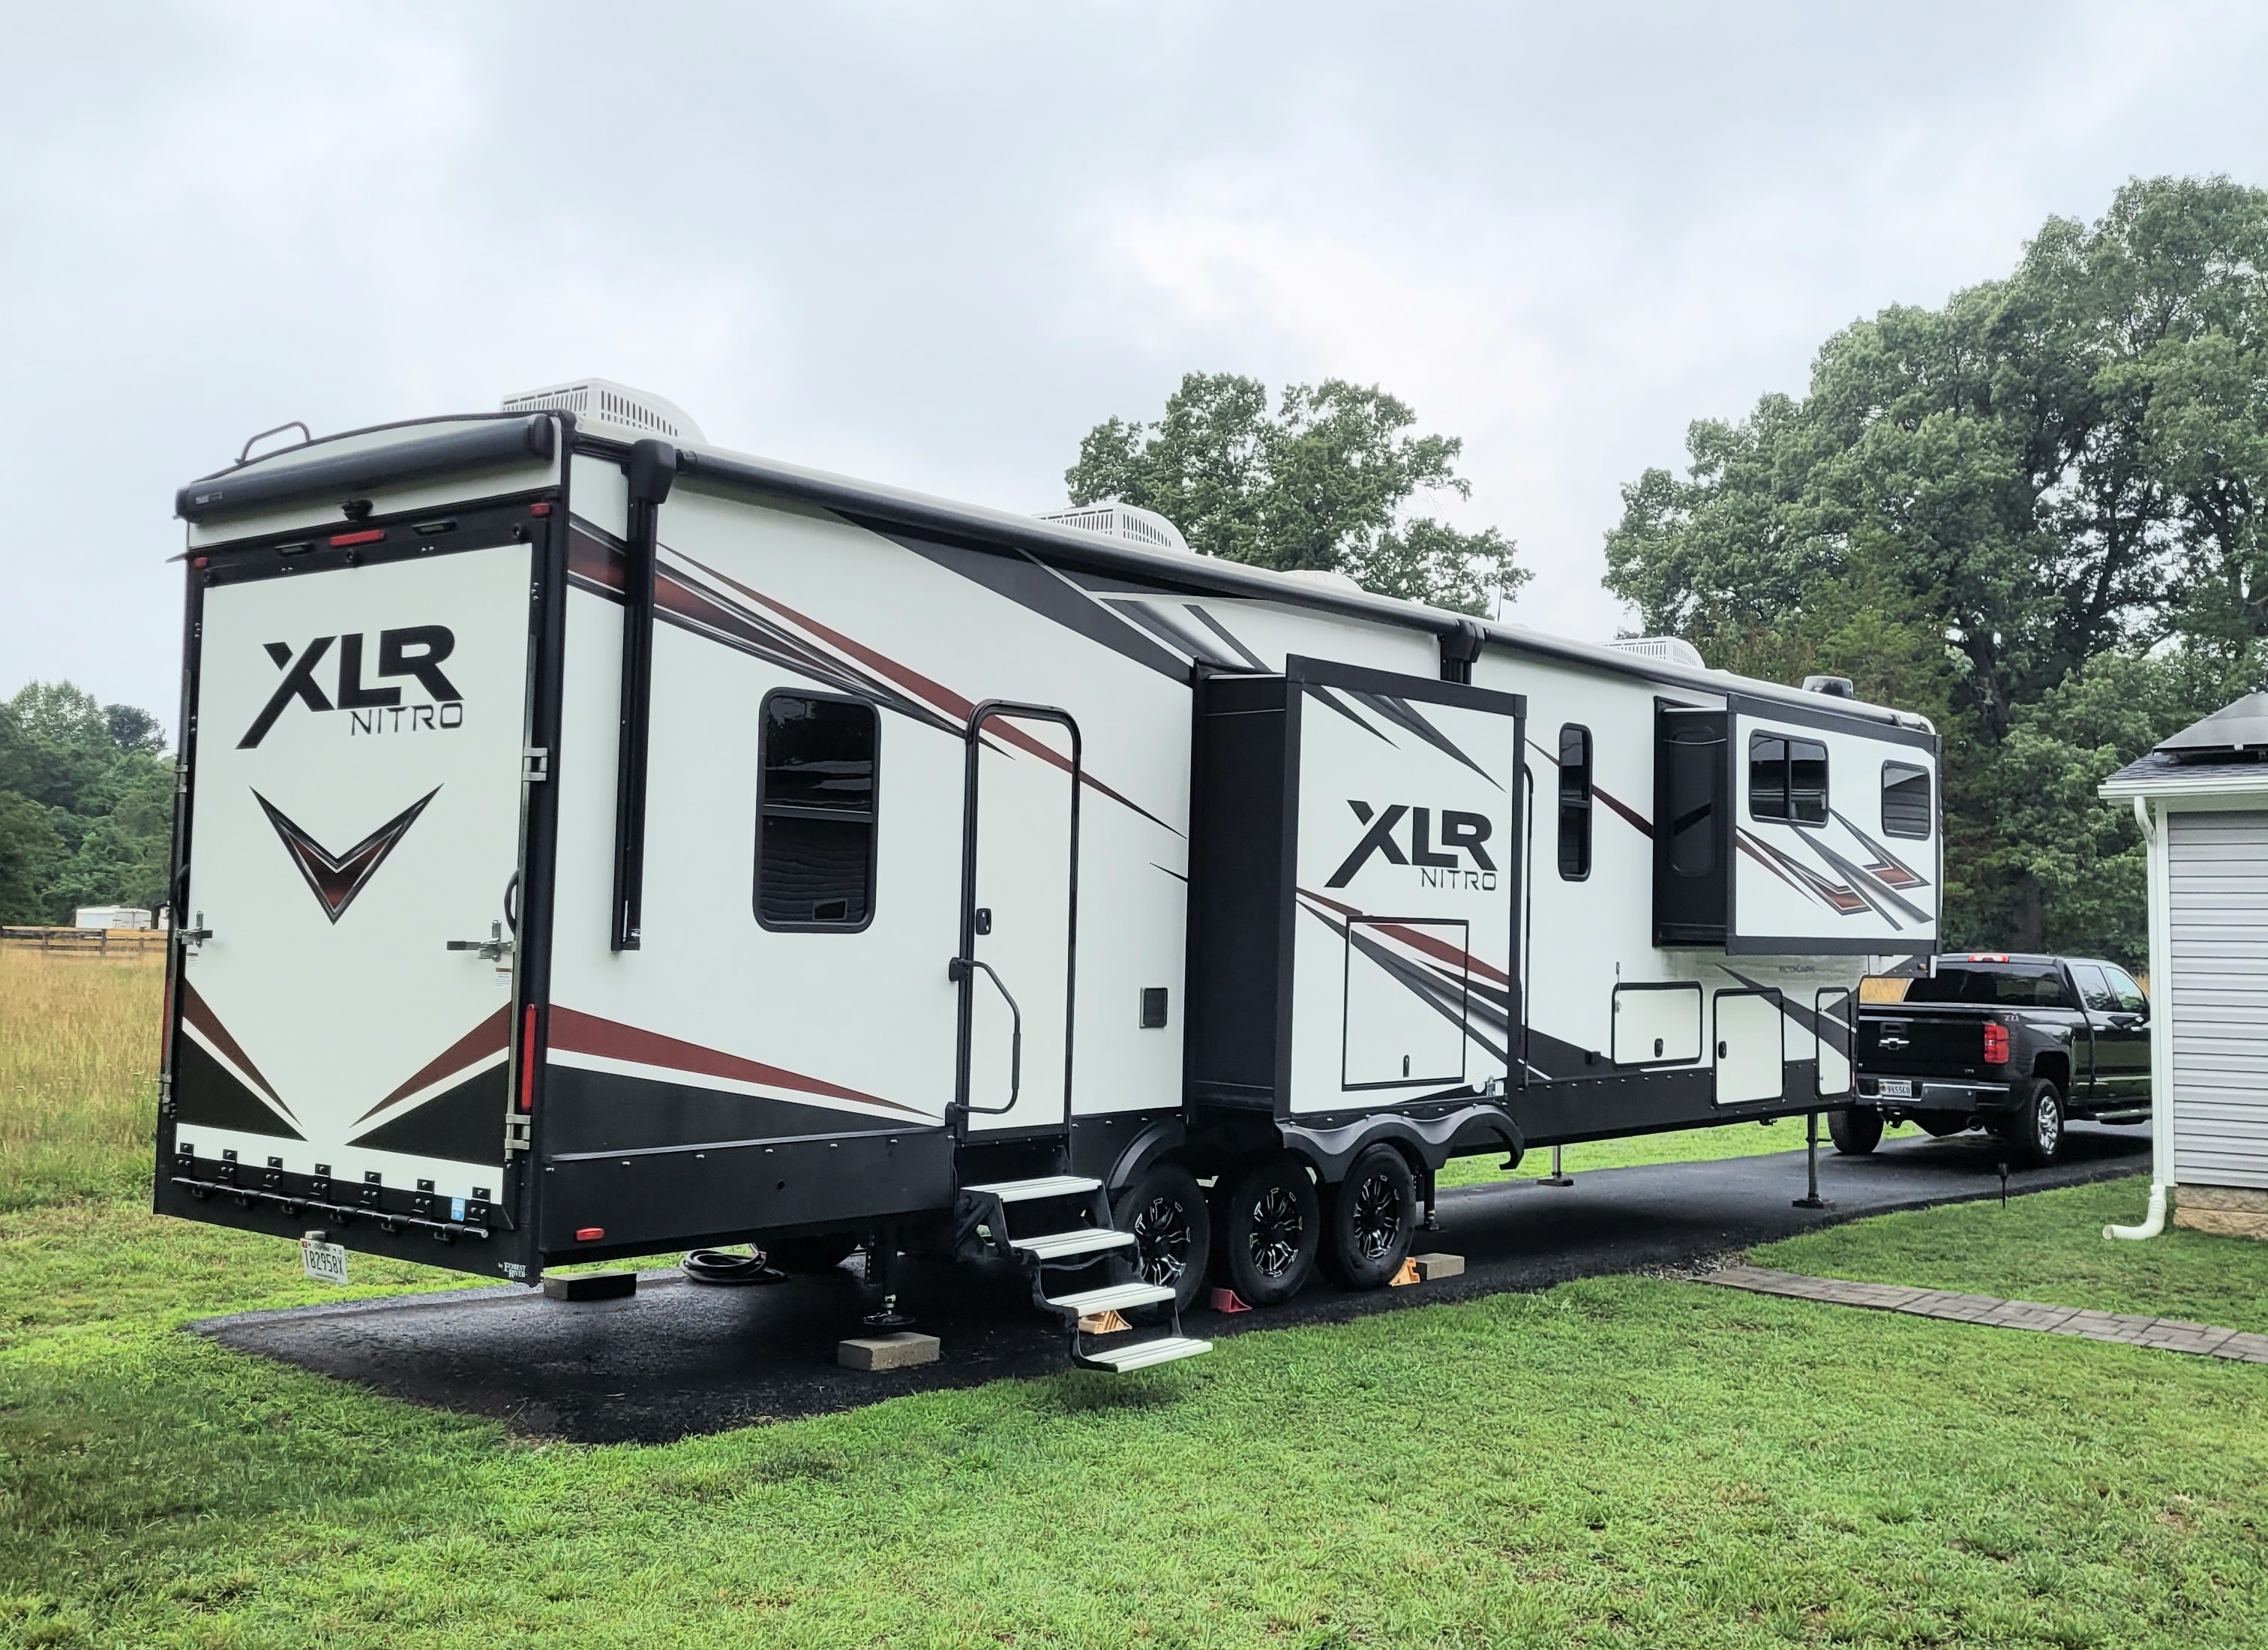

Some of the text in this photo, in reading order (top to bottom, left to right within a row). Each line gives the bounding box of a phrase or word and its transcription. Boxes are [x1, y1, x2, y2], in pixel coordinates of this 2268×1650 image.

[235, 625, 464, 749] XLR
[350, 702, 463, 736] NITRO
[1324, 800, 1498, 888] XLR
[1420, 868, 1496, 891] NITRO
[503, 1262, 526, 1273] FOREST
[508, 1269, 526, 1278] RIVER
